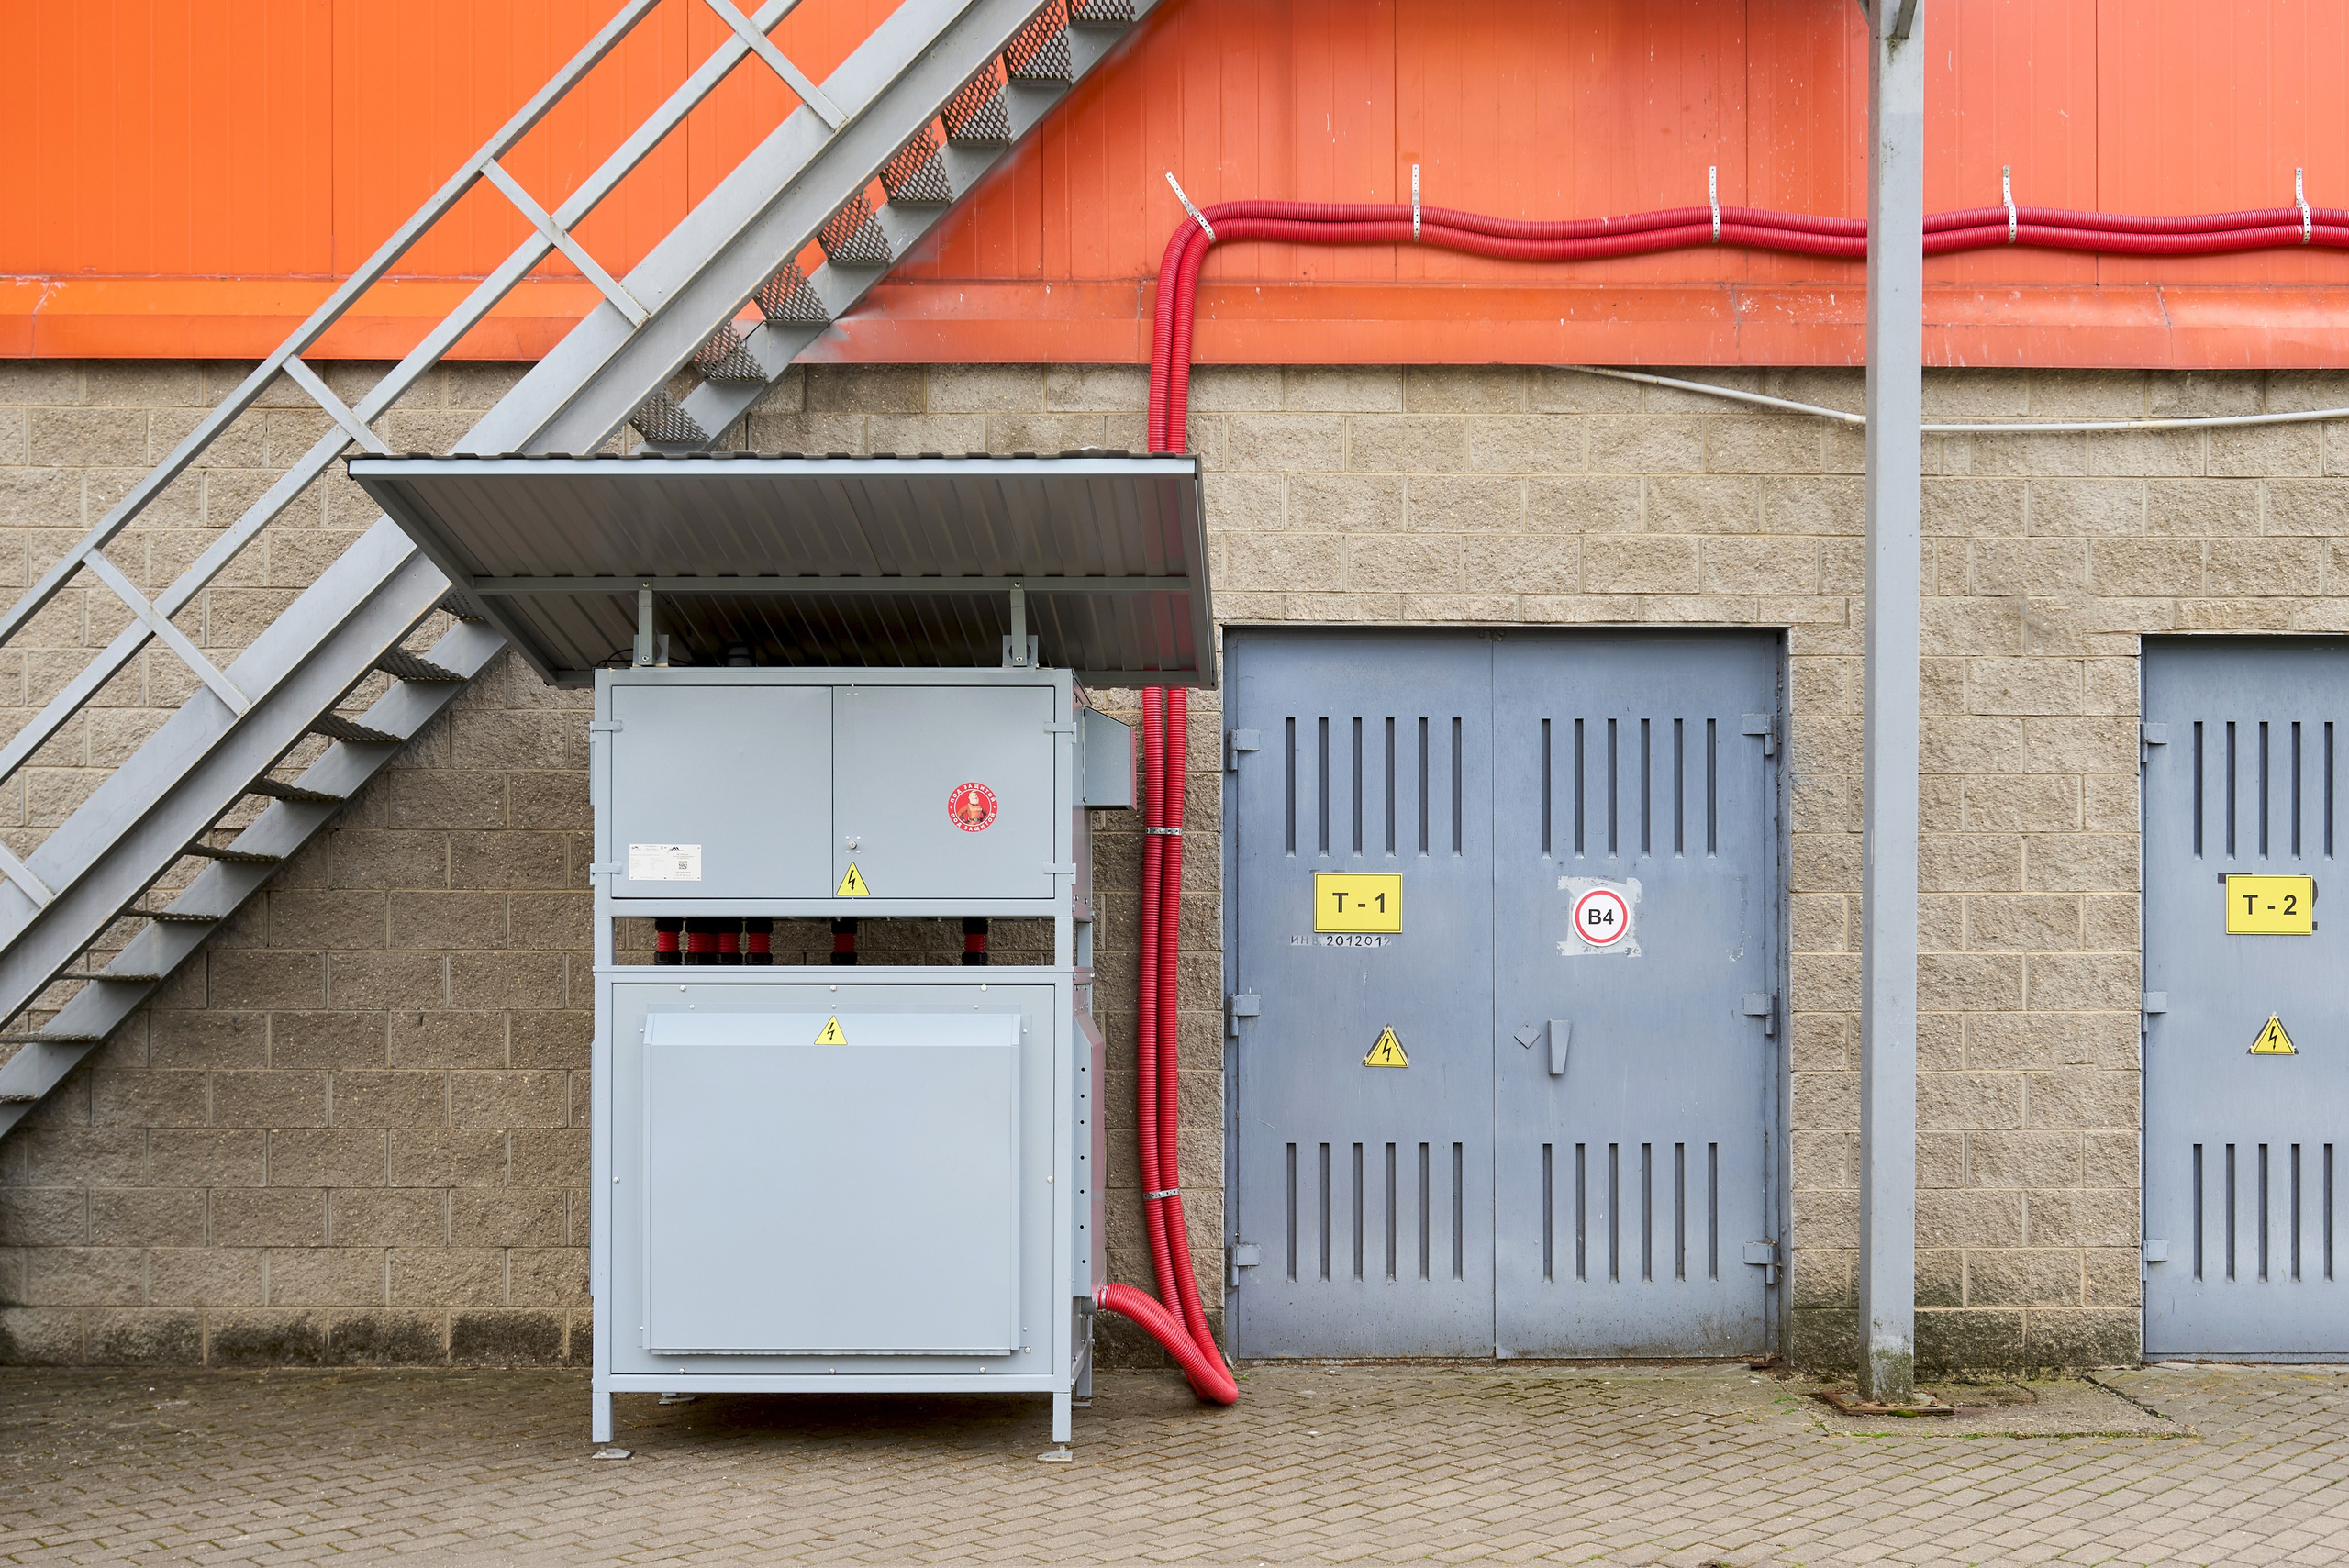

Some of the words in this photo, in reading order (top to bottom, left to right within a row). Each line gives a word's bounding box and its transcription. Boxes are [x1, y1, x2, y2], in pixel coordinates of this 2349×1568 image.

[951, 789, 962, 803] ПОД
[963, 784, 996, 802] ЗАЩИТОЙ
[951, 813, 962, 828] ПОД
